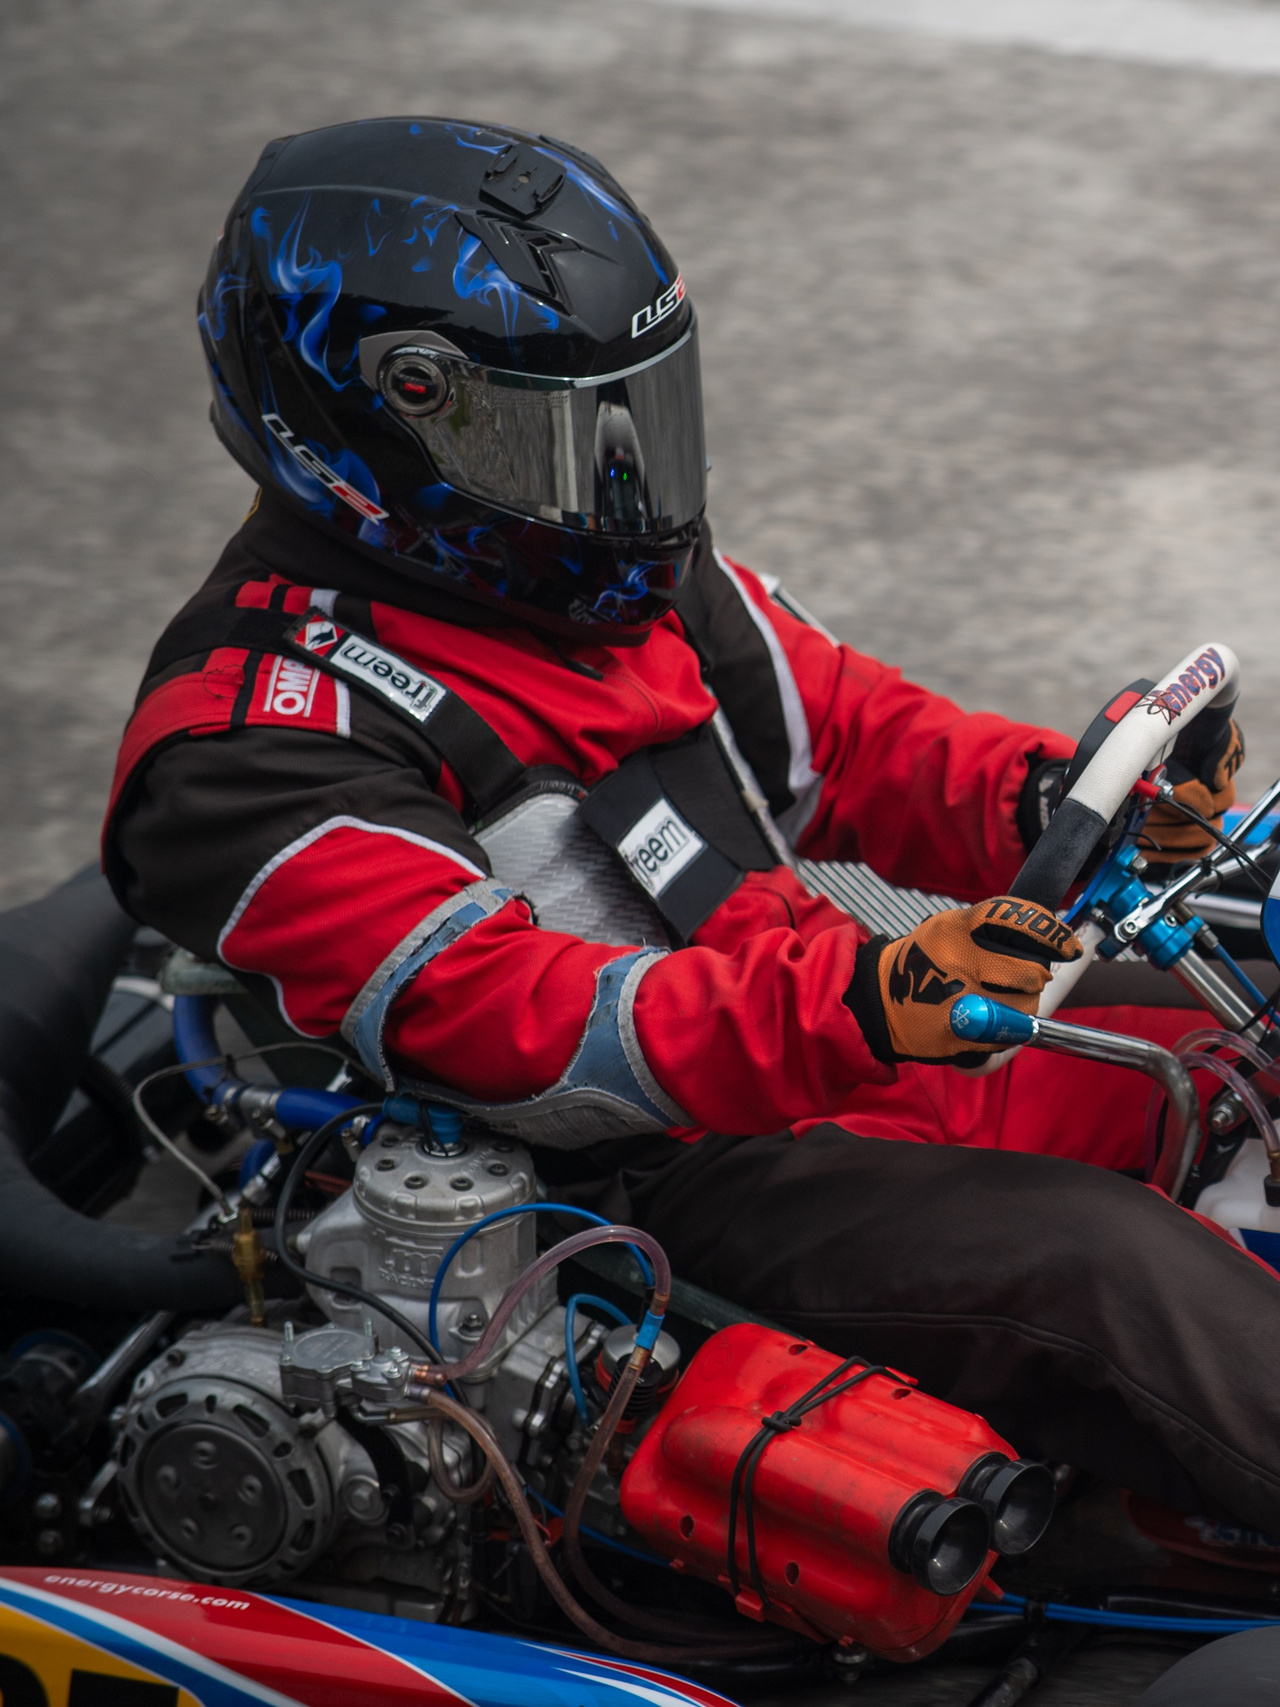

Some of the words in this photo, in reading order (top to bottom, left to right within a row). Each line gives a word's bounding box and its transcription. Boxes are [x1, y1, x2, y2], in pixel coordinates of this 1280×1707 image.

[631, 271, 686, 338] LS2
[261, 413, 390, 526] LS2
[272, 656, 316, 716] OMP
[340, 641, 439, 711] freem
[1148, 647, 1226, 723] Energy
[985, 899, 1072, 950] THOR
[44, 1574, 250, 1611] energycorse.com
